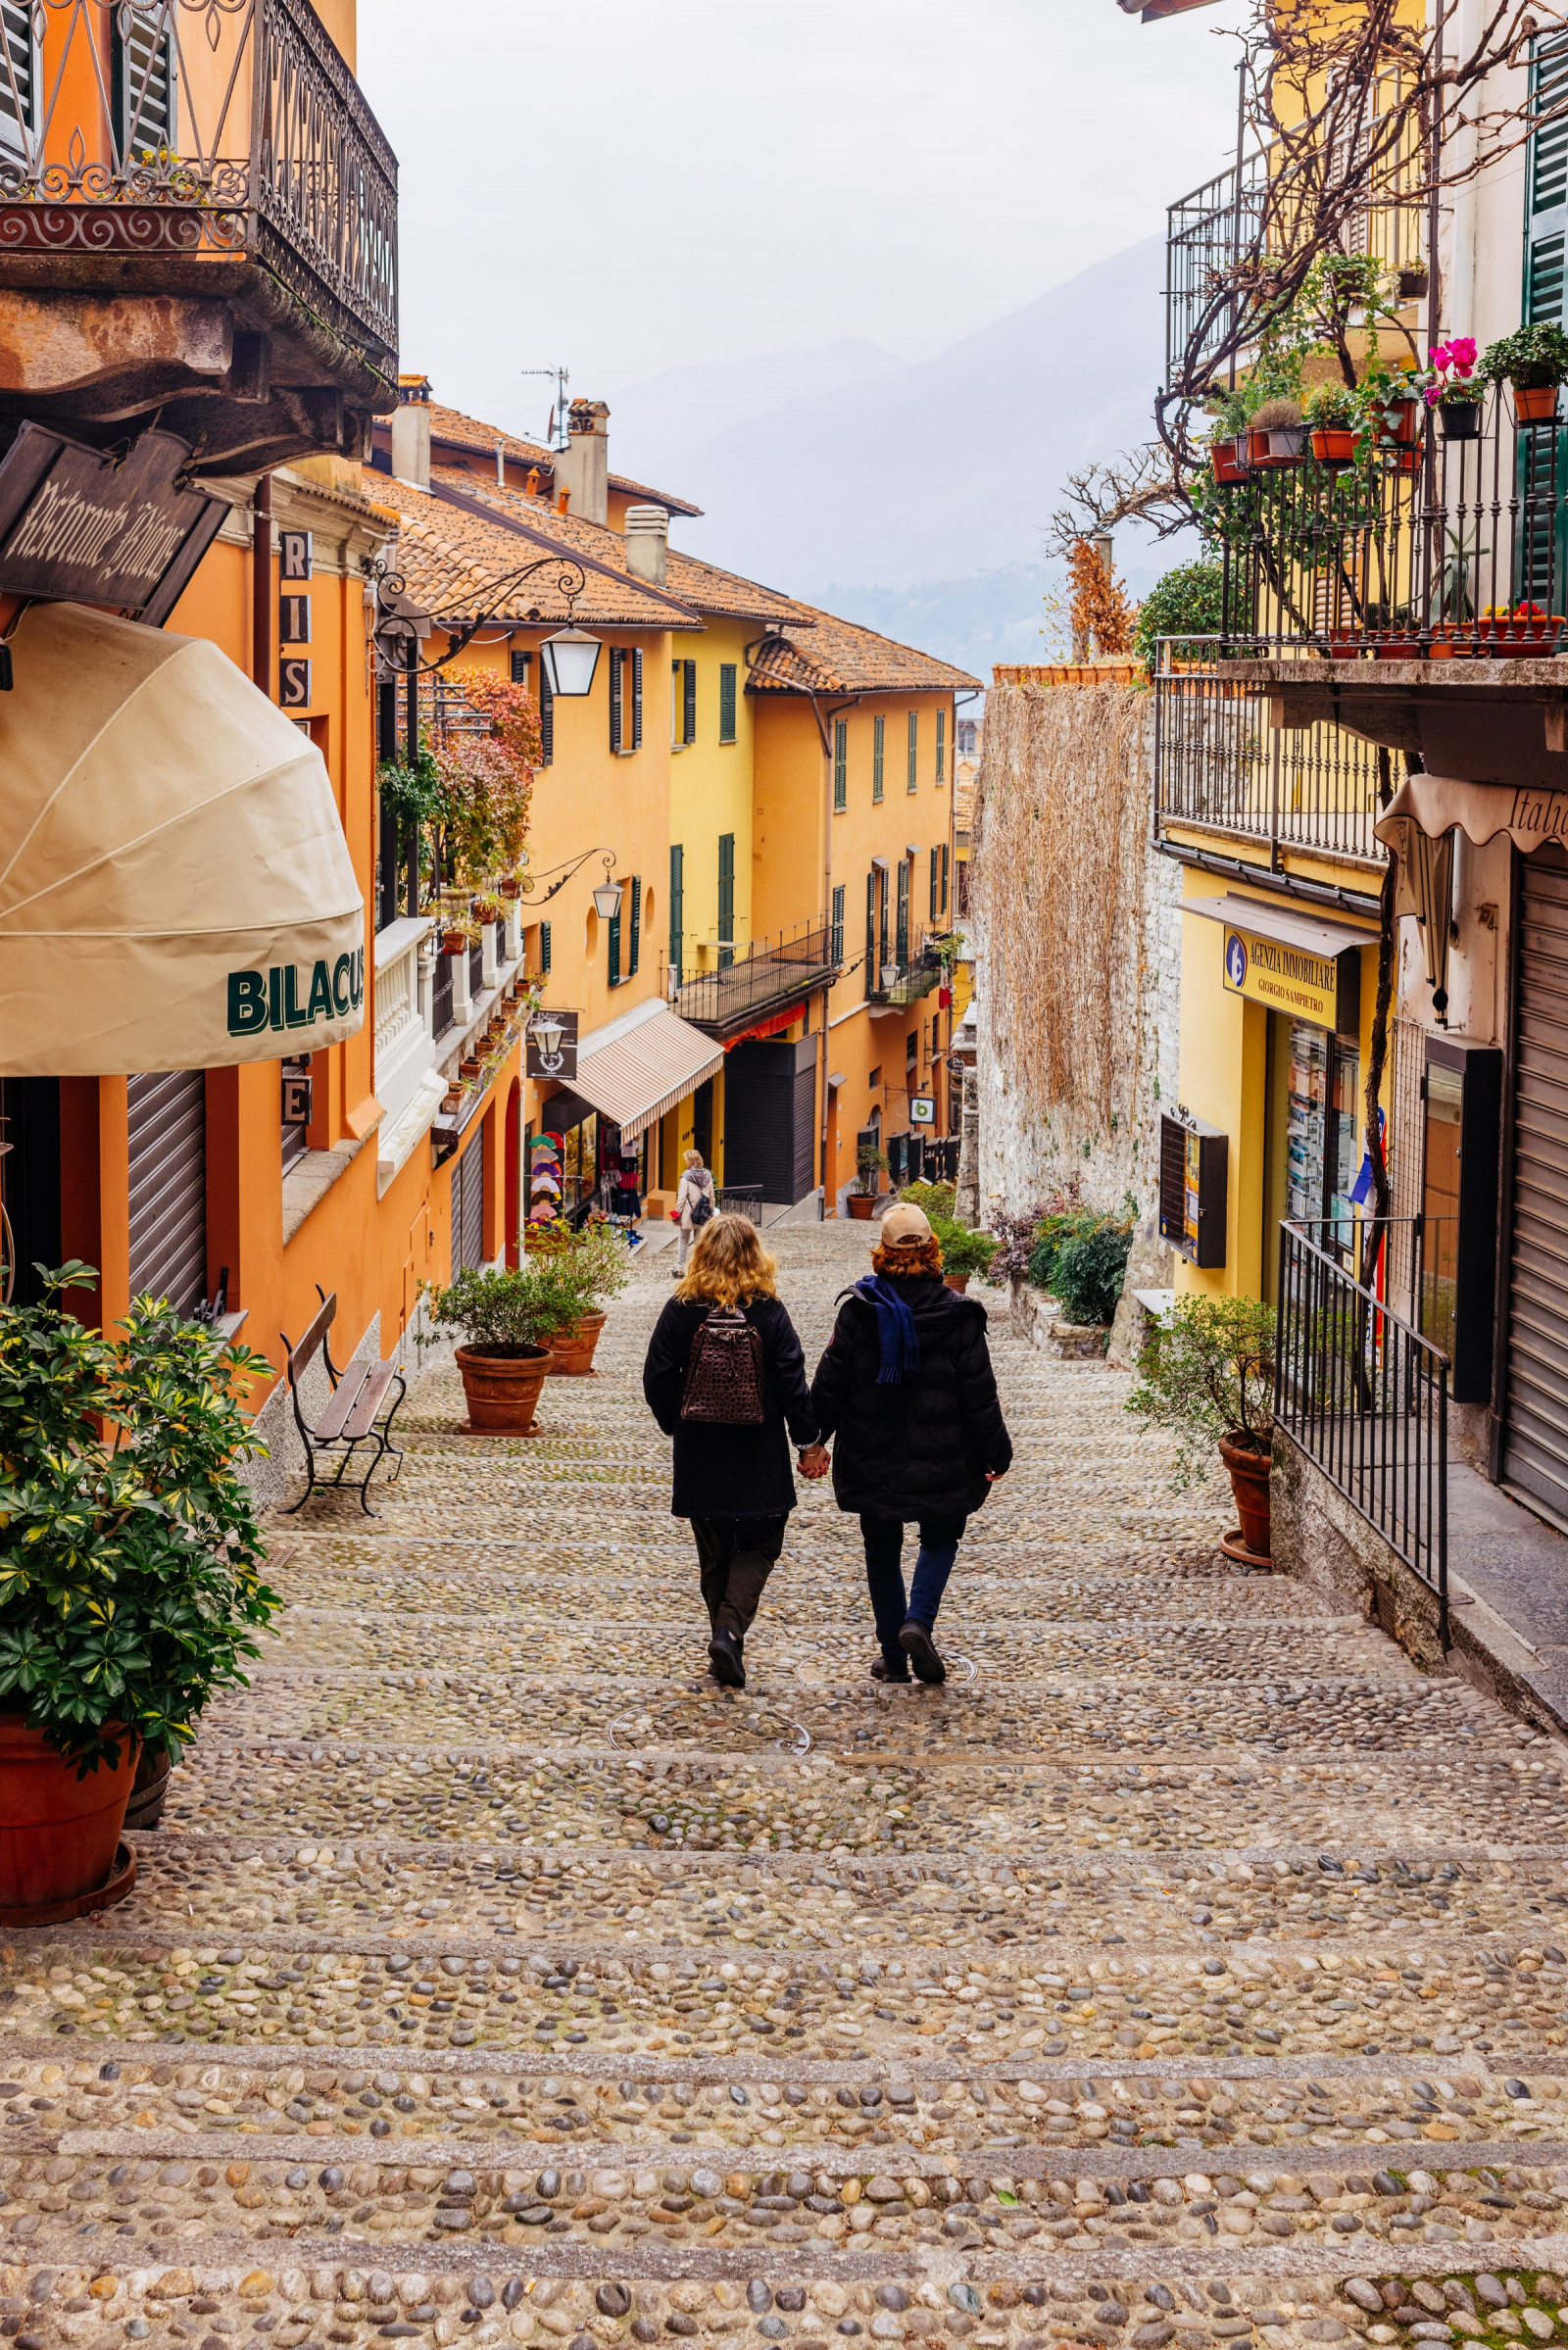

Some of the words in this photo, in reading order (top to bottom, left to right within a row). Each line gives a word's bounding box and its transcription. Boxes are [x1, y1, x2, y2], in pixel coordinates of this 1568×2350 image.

[4, 476, 130, 569] Ristorante
[95, 501, 186, 586] Bilacus
[1250, 940, 1282, 974] AGENZIA
[1282, 951, 1336, 993] IMMOBILIARE
[1257, 978, 1286, 1000] GIORGIO
[1285, 988, 1324, 1013] SAMPIETRO
